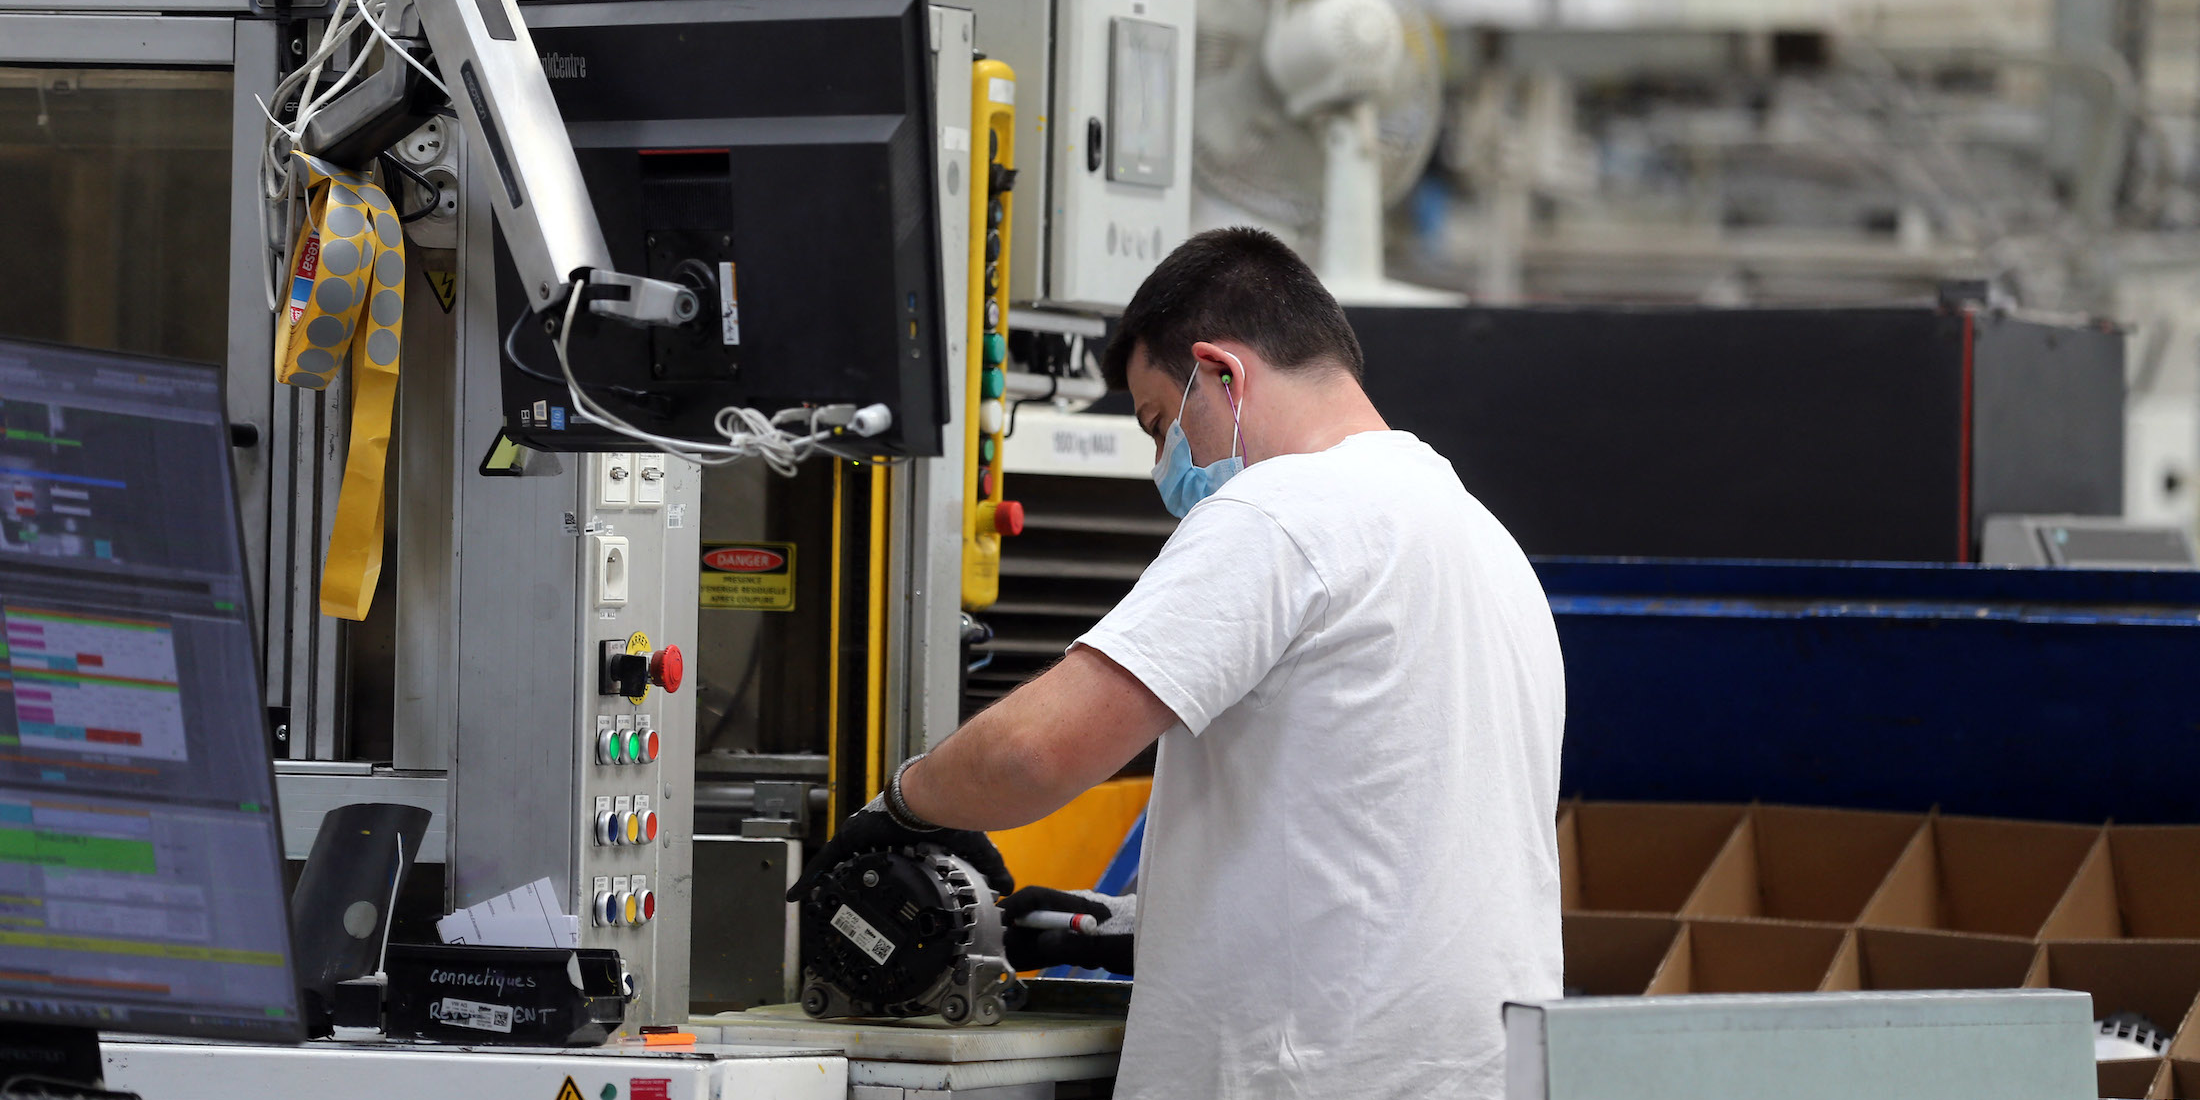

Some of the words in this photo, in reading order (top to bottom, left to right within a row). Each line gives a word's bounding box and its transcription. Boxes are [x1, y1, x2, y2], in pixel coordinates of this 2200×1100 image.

[541, 52, 586, 79] nkCentre
[717, 553, 769, 567] DANGER
[631, 634, 648, 649] ARRET
[430, 967, 537, 997] connectiques
